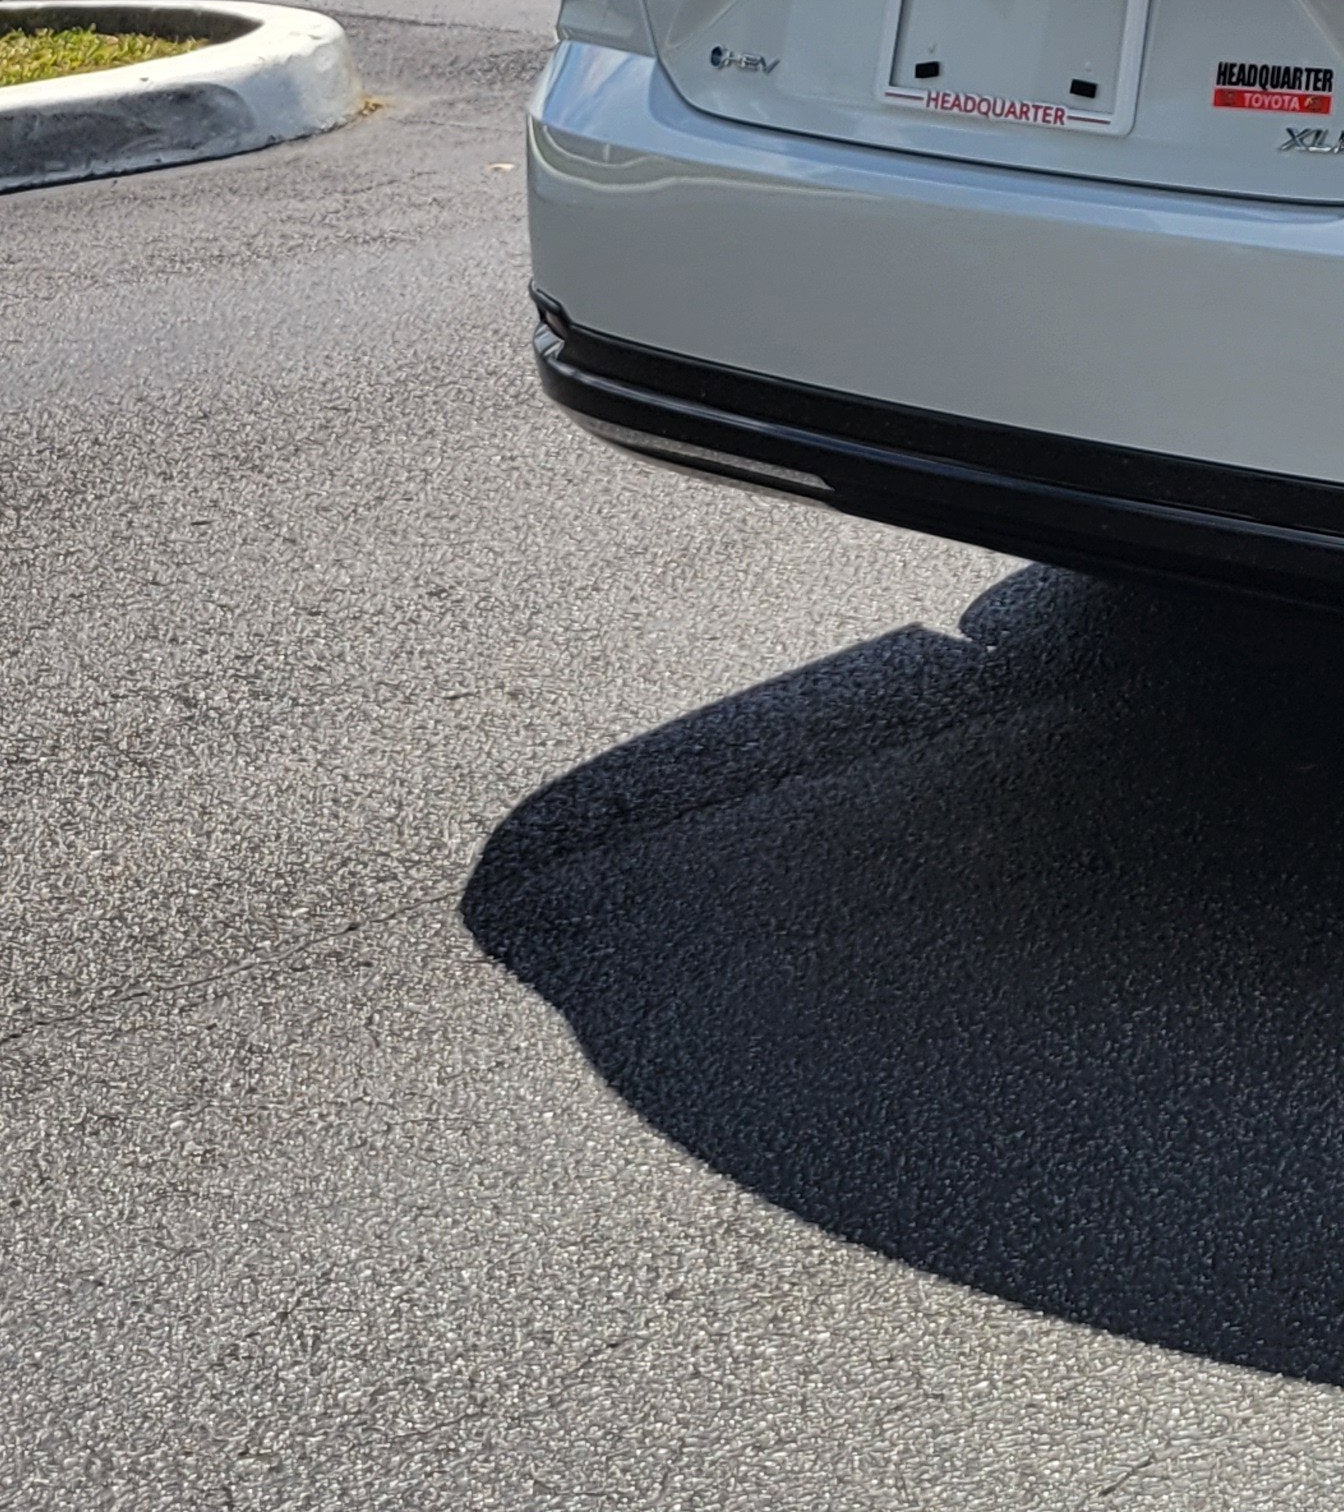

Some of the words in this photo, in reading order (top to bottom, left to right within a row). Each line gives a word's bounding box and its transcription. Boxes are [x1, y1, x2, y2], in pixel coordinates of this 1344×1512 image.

[1216, 61, 1333, 92] HEADQUARTER
[925, 90, 1066, 126] HEADQUARTER
[1244, 93, 1300, 110] TOYOTA
